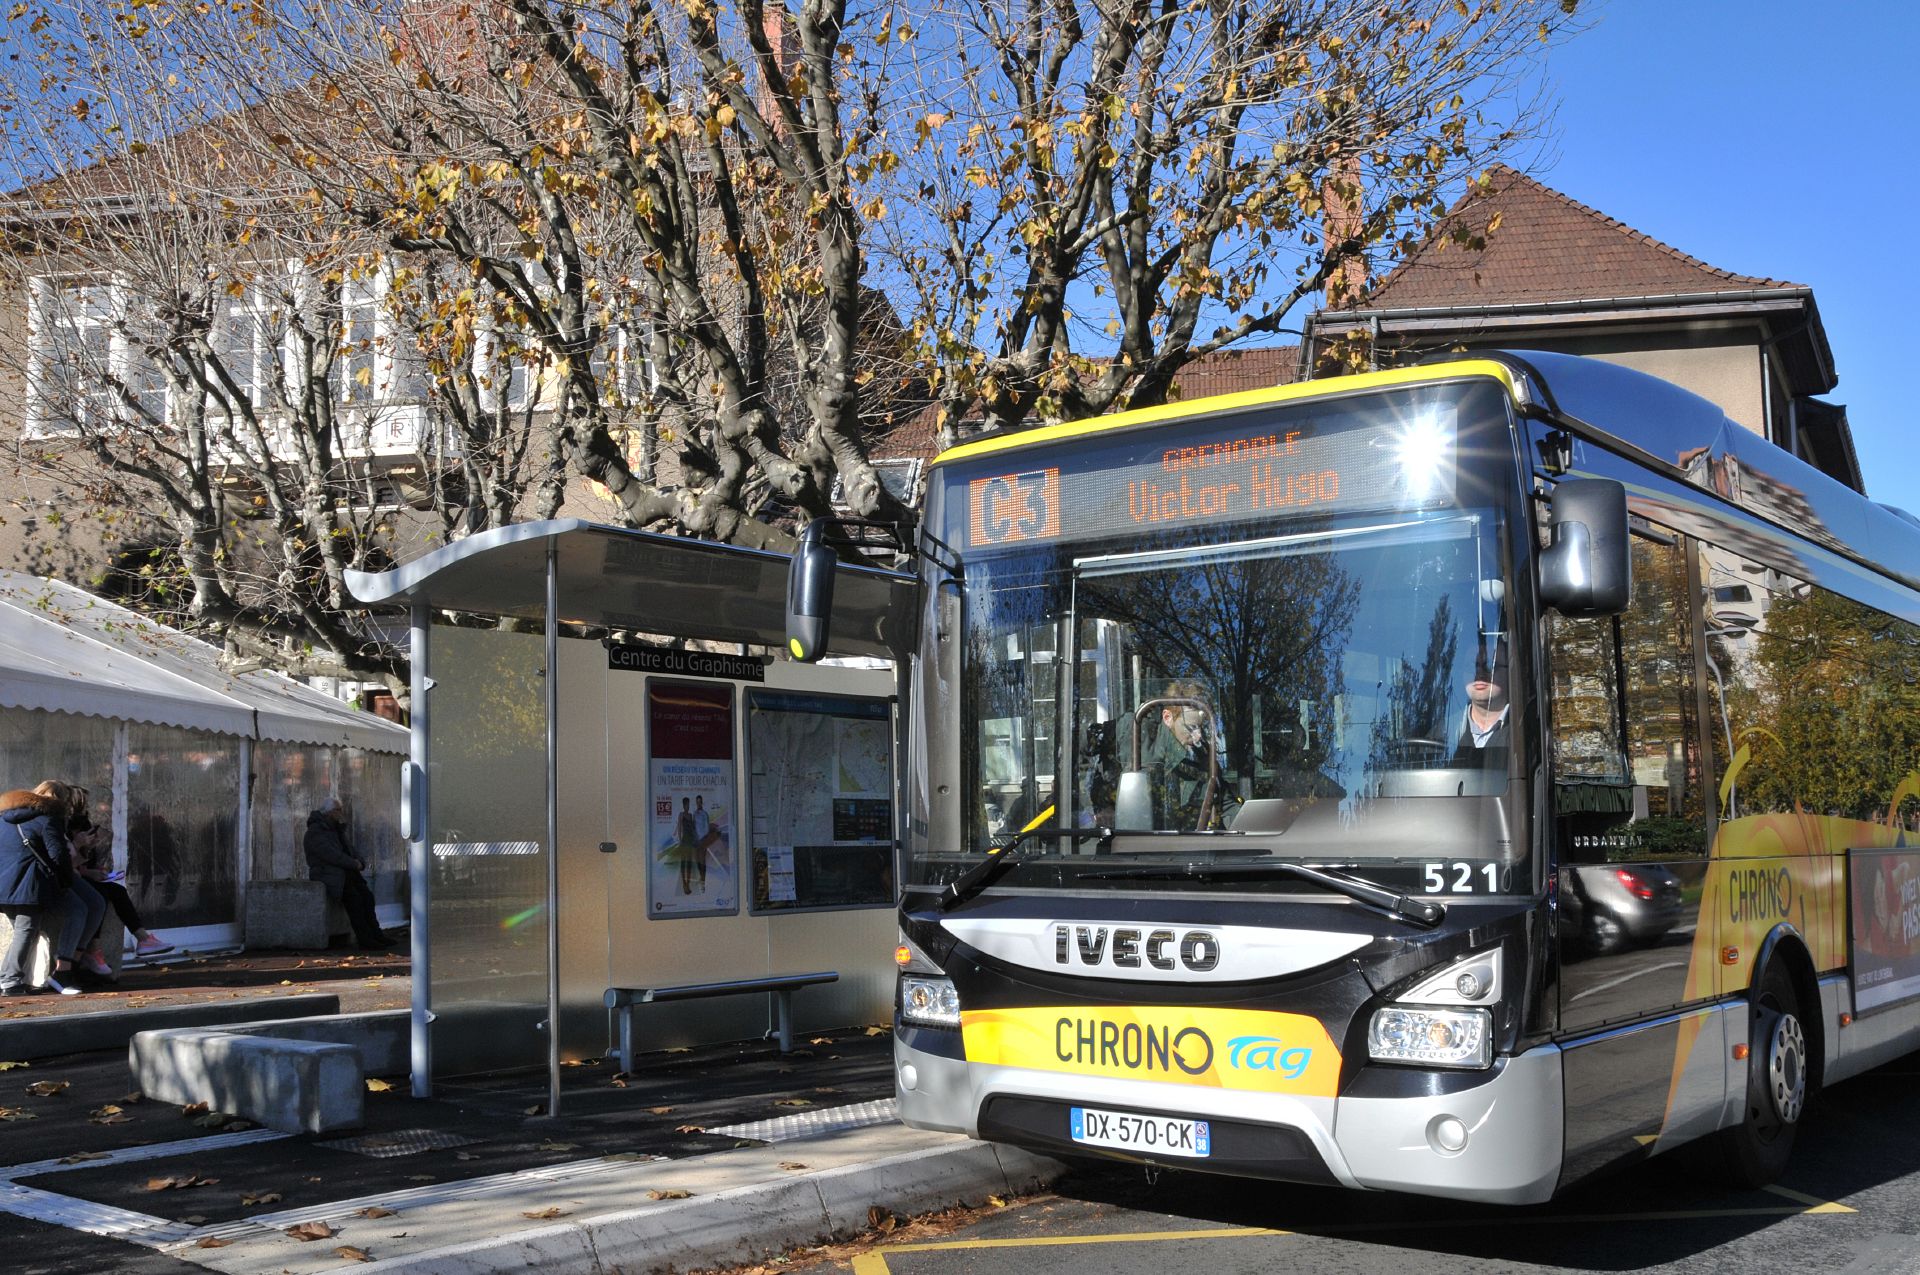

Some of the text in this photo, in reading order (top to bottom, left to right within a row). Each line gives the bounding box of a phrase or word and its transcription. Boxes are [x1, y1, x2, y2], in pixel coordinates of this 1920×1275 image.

[1163, 431, 1301, 472] GRENOBLE
[981, 469, 1049, 544] C3
[1129, 464, 1339, 522] Victor Hugo
[610, 646, 764, 677] Centre du Graphisme
[657, 775, 727, 786] UN TARIF POUR CHACUN
[1574, 835, 1642, 848] URBANWAY
[1424, 863, 1498, 893] 521
[1729, 867, 1792, 923] CHRONO
[1055, 925, 1220, 972] IVECO
[1056, 1017, 1213, 1075] CHRONO
[1227, 1036, 1312, 1080] Tag
[1086, 1113, 1192, 1149] DX-570-CK
[1196, 1139, 1206, 1151] 38
